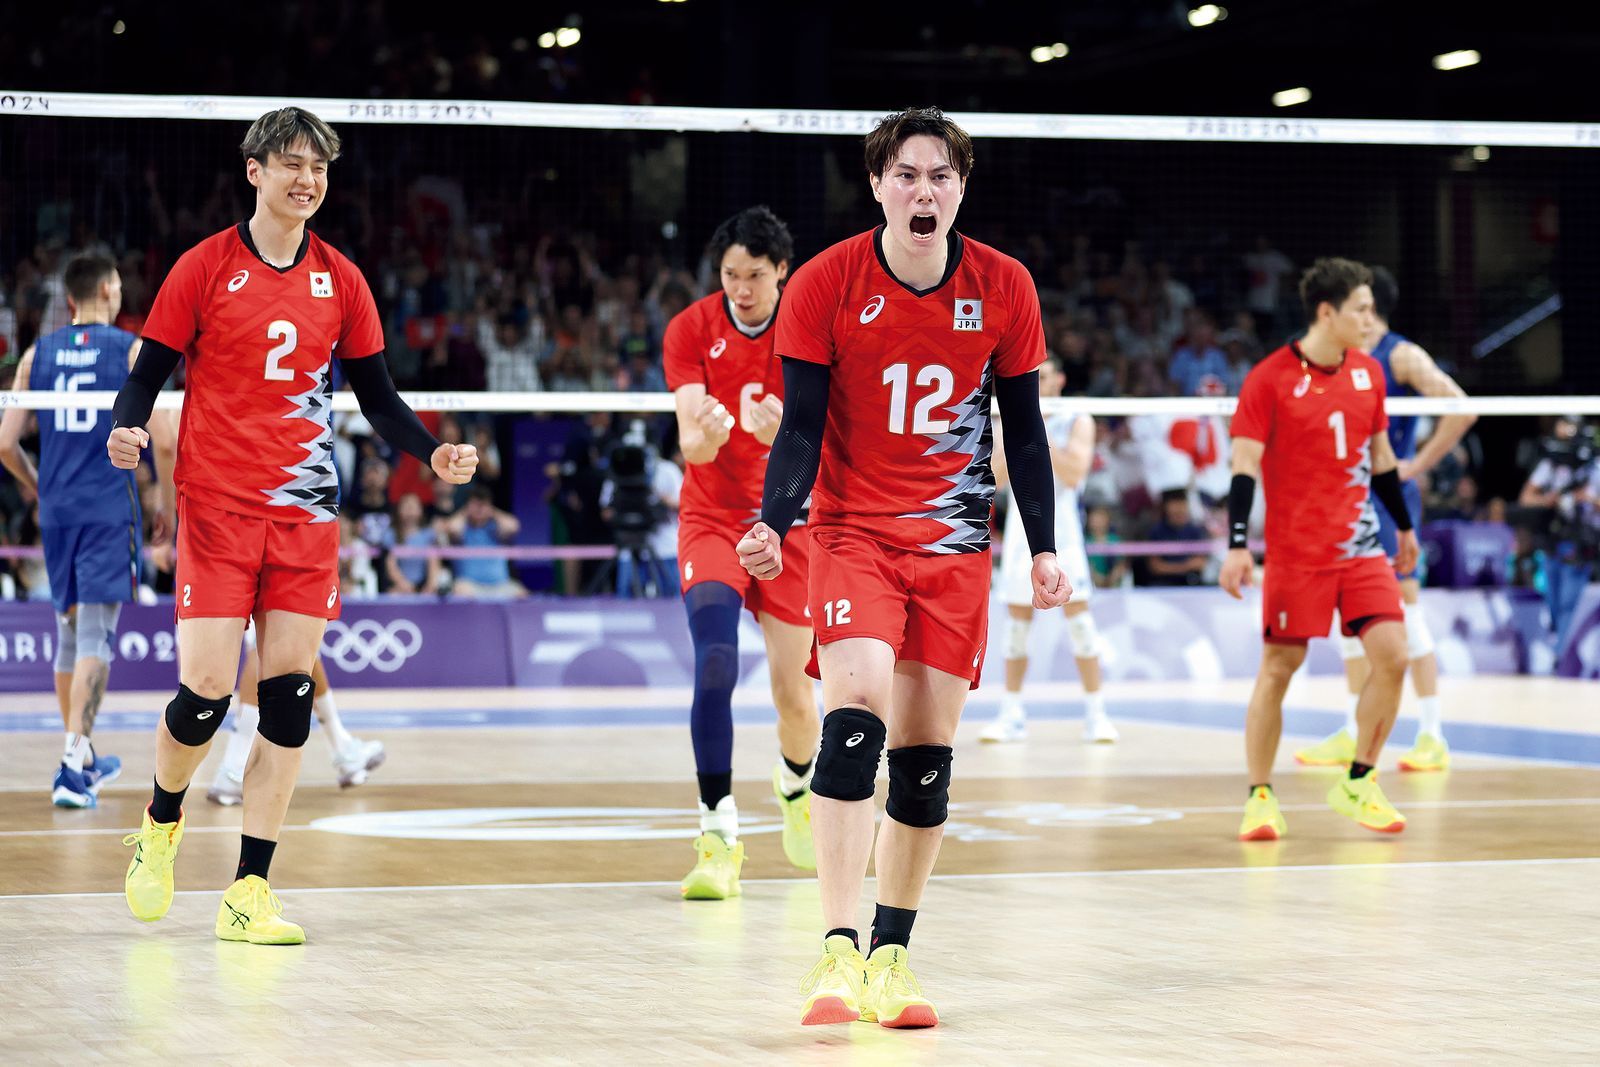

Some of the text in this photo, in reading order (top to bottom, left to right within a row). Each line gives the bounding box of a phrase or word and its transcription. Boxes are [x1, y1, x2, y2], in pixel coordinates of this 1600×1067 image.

[349, 104, 493, 119] PARIS 2024
[958, 320, 977, 329] JPN
[263, 319, 298, 381] 2
[54, 371, 98, 432] 16
[882, 362, 954, 435] 12
[1328, 410, 1348, 460] 1
[684, 560, 694, 581] 6
[183, 583, 192, 608] 2
[823, 598, 852, 628] 12
[1278, 610, 1288, 631] 1
